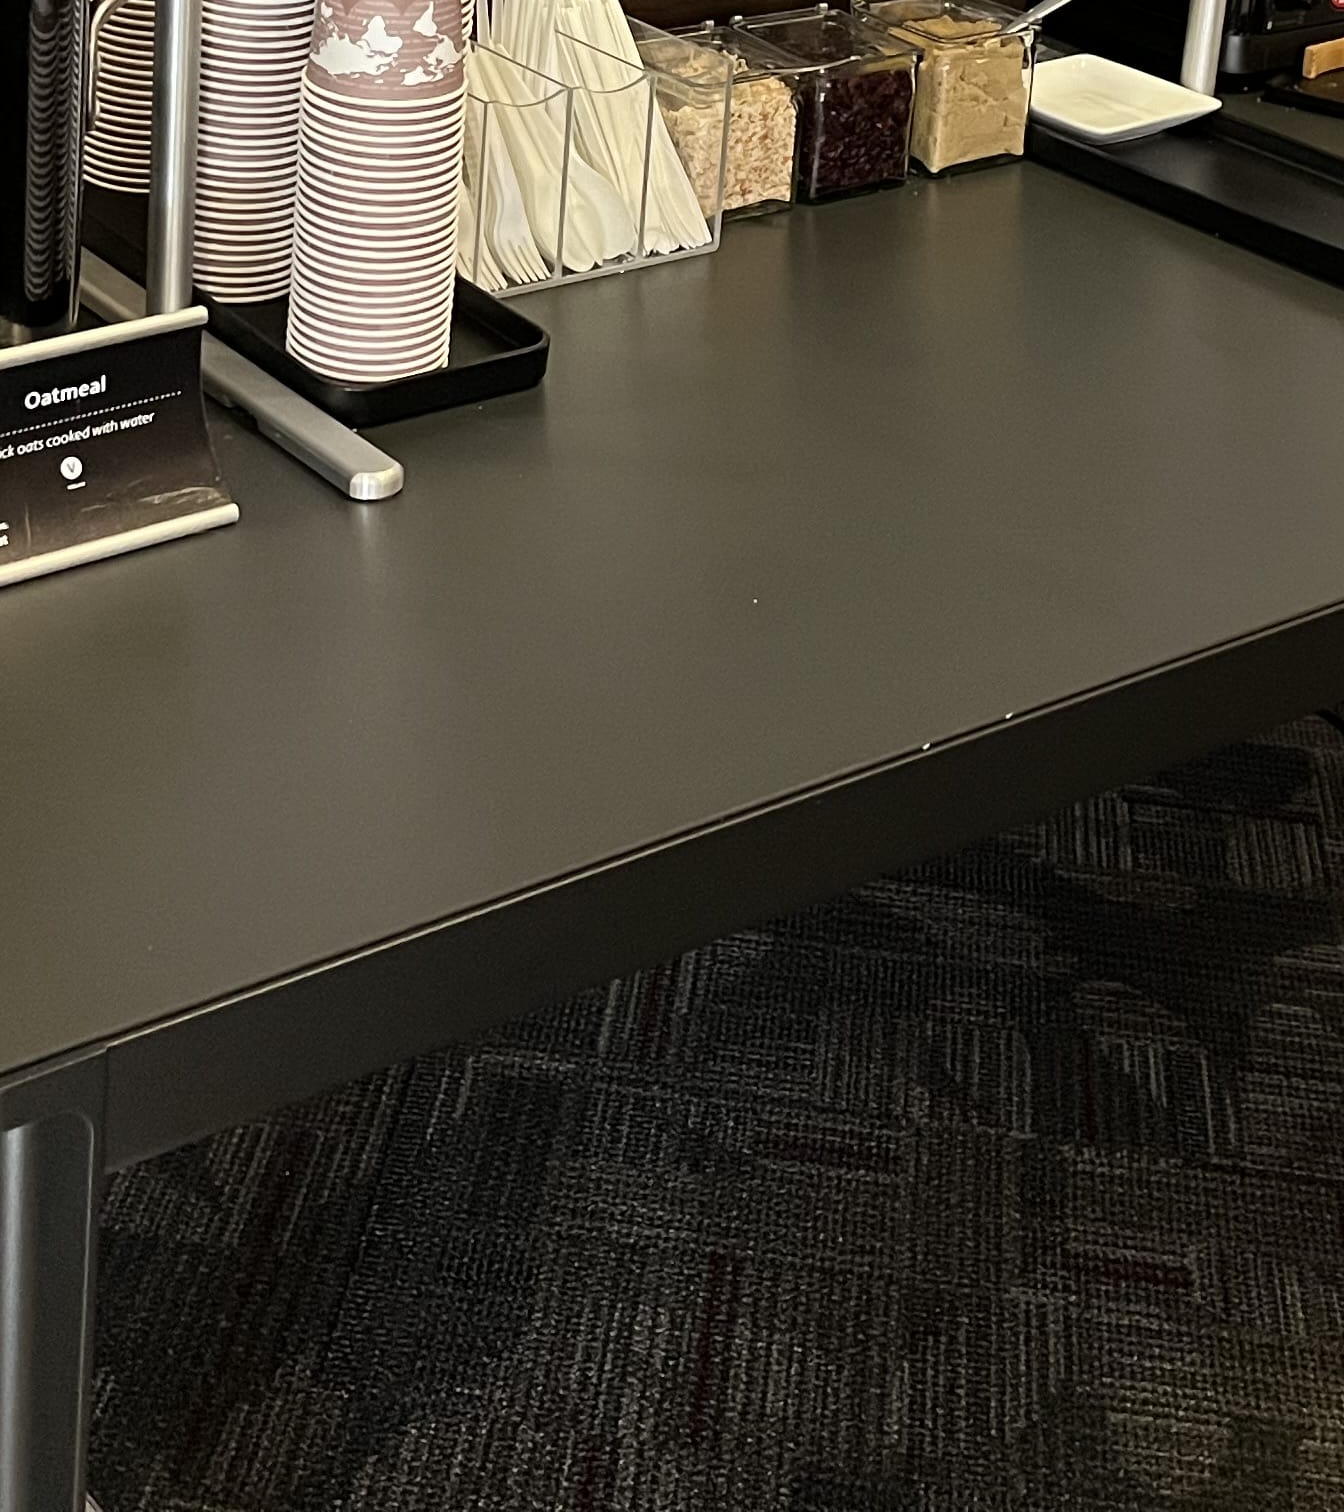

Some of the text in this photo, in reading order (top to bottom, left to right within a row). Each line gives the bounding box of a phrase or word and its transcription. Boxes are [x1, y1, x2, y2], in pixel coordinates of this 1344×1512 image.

[24, 374, 106, 409] Oatmeal
[17, 437, 44, 455] oats
[46, 425, 91, 448] cooked
[92, 420, 118, 437] with
[120, 412, 155, 429] water
